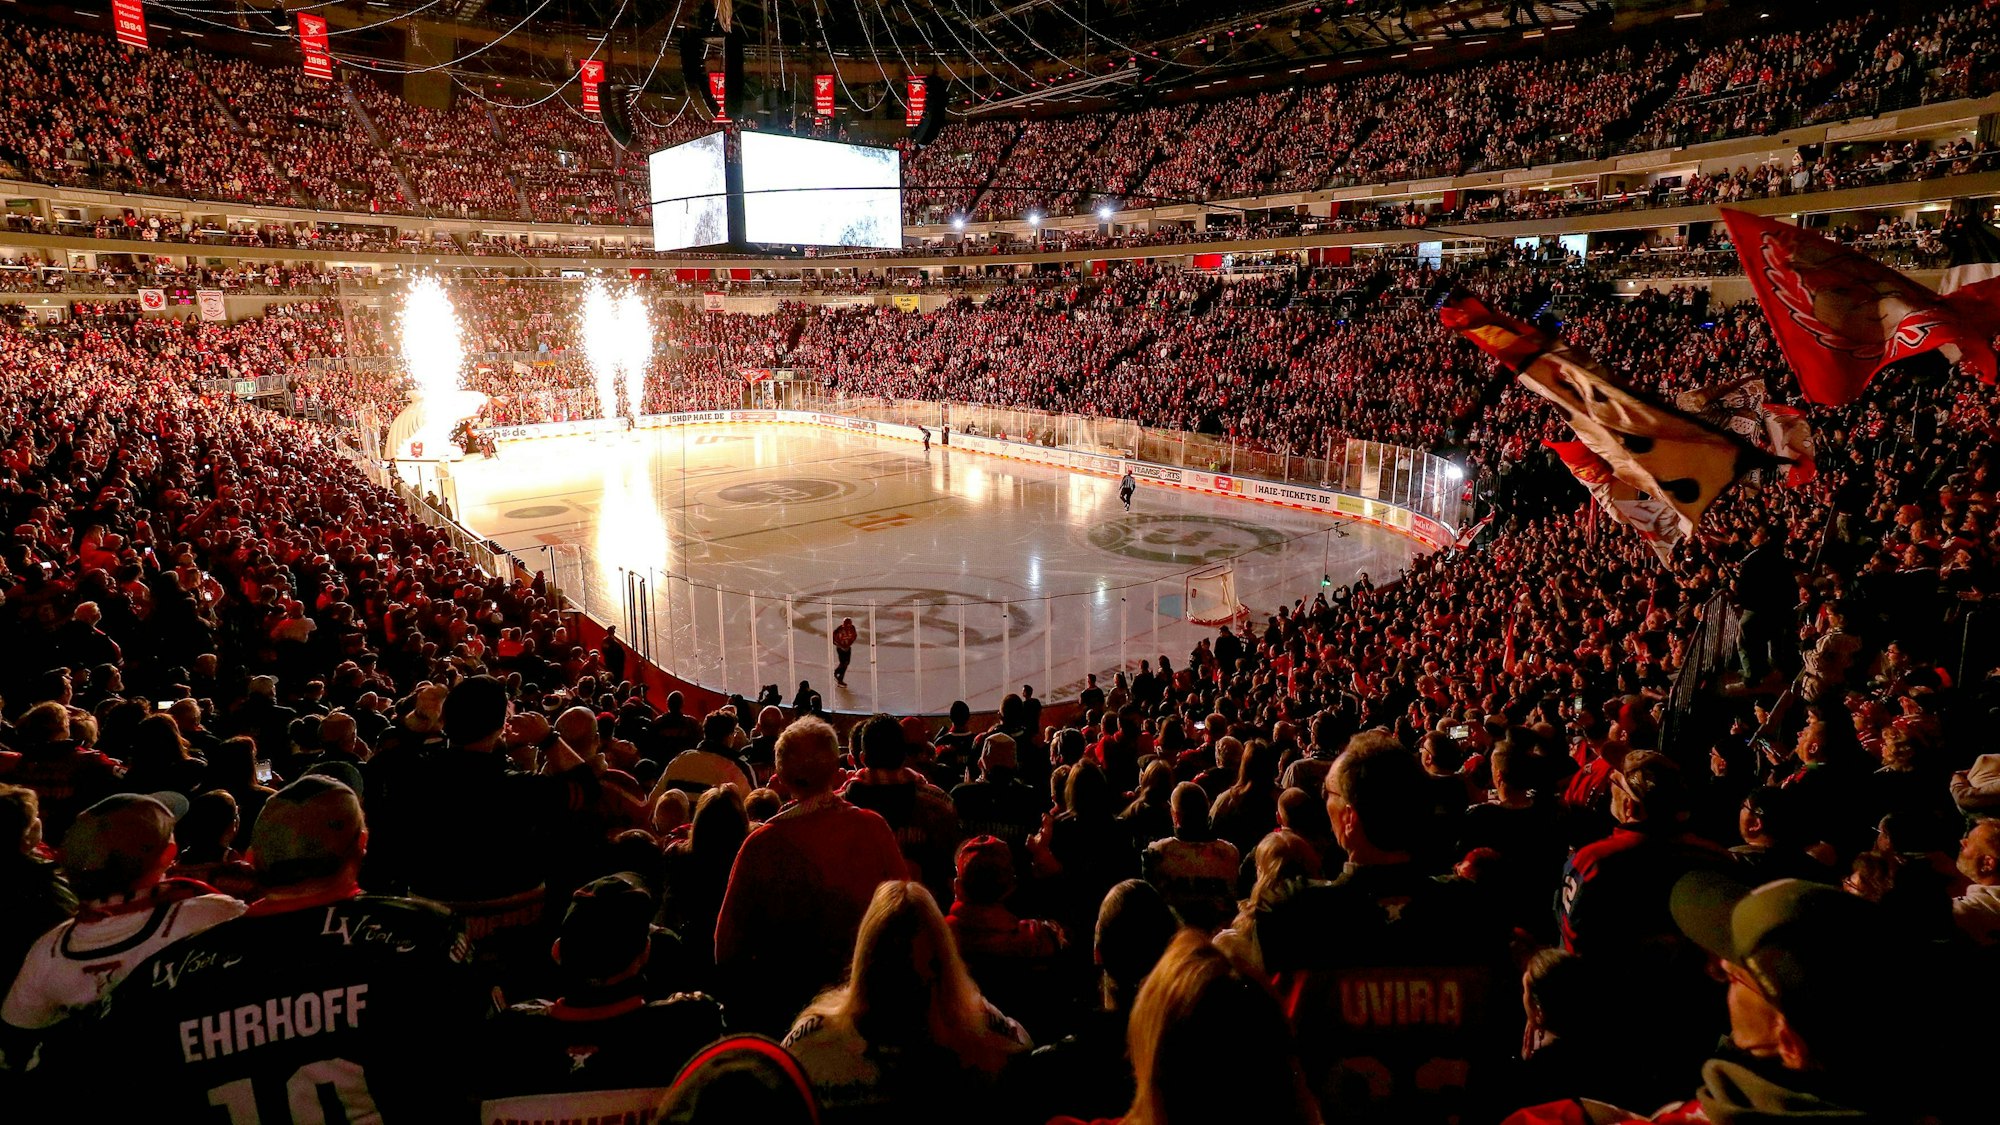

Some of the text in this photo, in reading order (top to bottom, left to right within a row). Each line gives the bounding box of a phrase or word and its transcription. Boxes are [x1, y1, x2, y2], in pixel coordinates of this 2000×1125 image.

[118, 10, 140, 20] Meister
[120, 20, 142, 32] 1984
[1258, 485, 1331, 504] HAIE-TICKETS.DE
[1339, 979, 1463, 1031] UVIRA
[179, 983, 369, 1064] EHRHOFF
